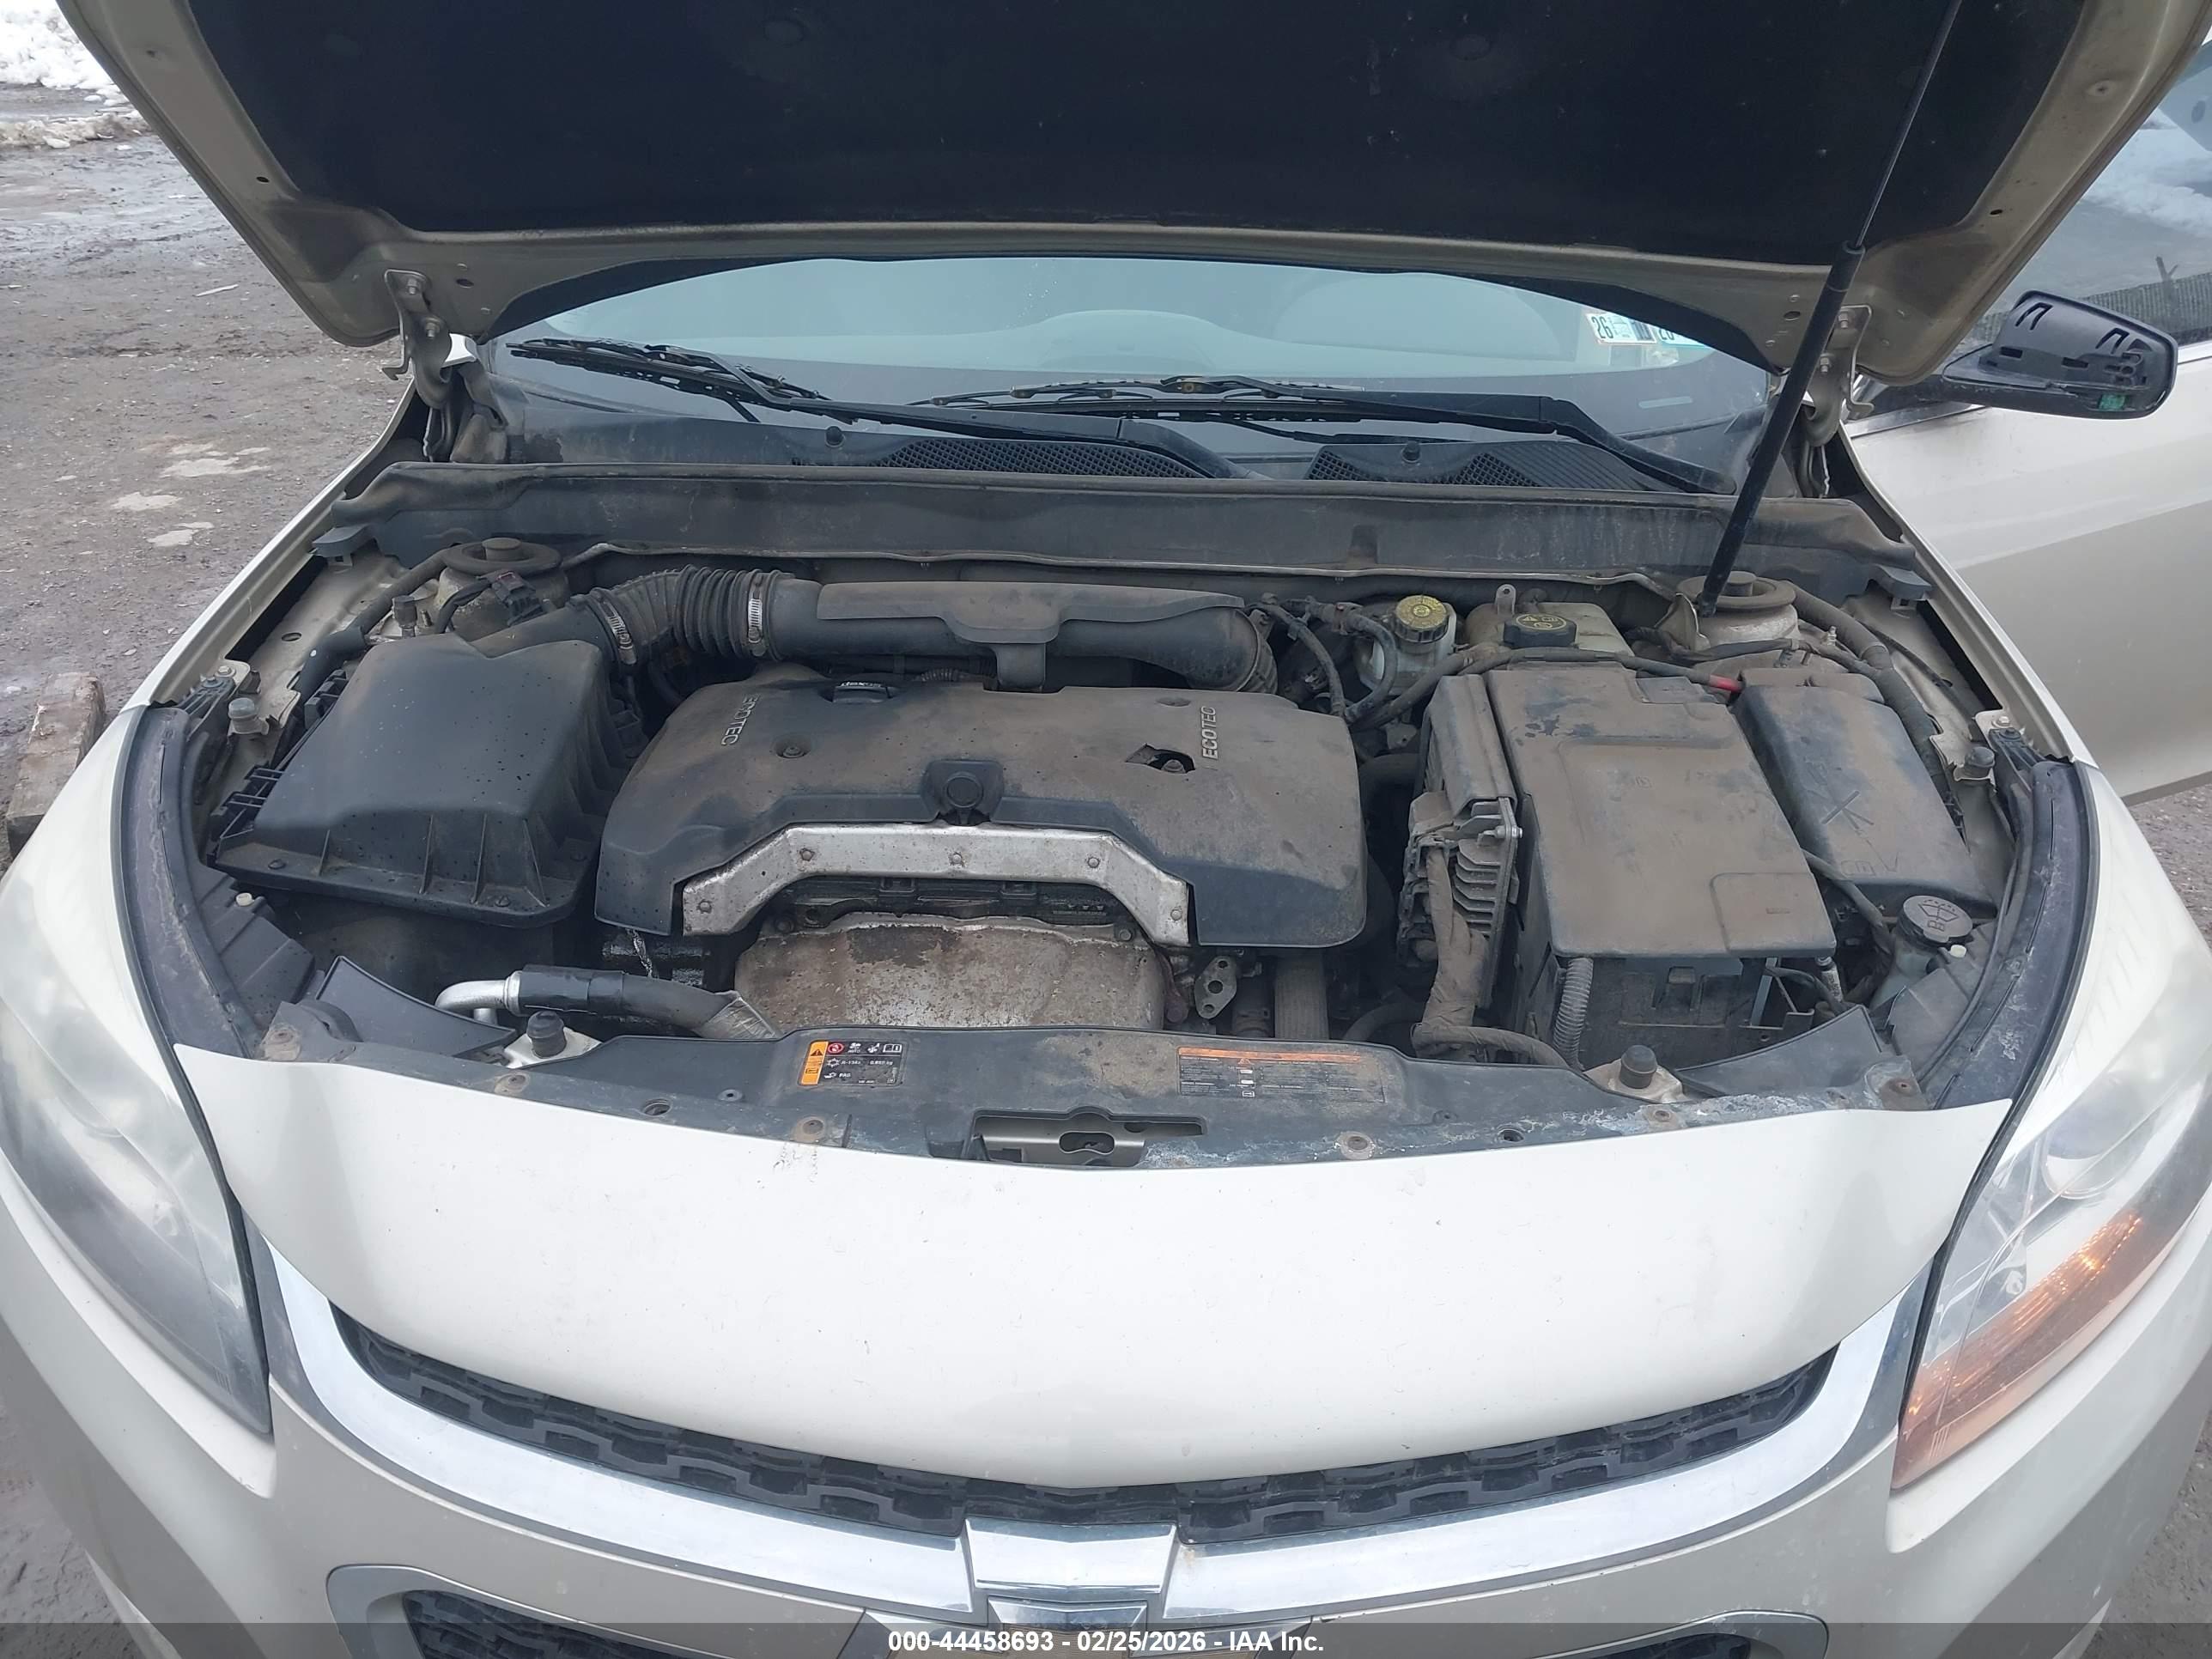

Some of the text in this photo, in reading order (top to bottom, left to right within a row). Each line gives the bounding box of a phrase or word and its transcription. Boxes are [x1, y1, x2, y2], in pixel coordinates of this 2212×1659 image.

[1591, 316, 1613, 339] 26
[720, 693, 763, 746] ECOTEC
[1200, 706, 1218, 759] ECOTEC
